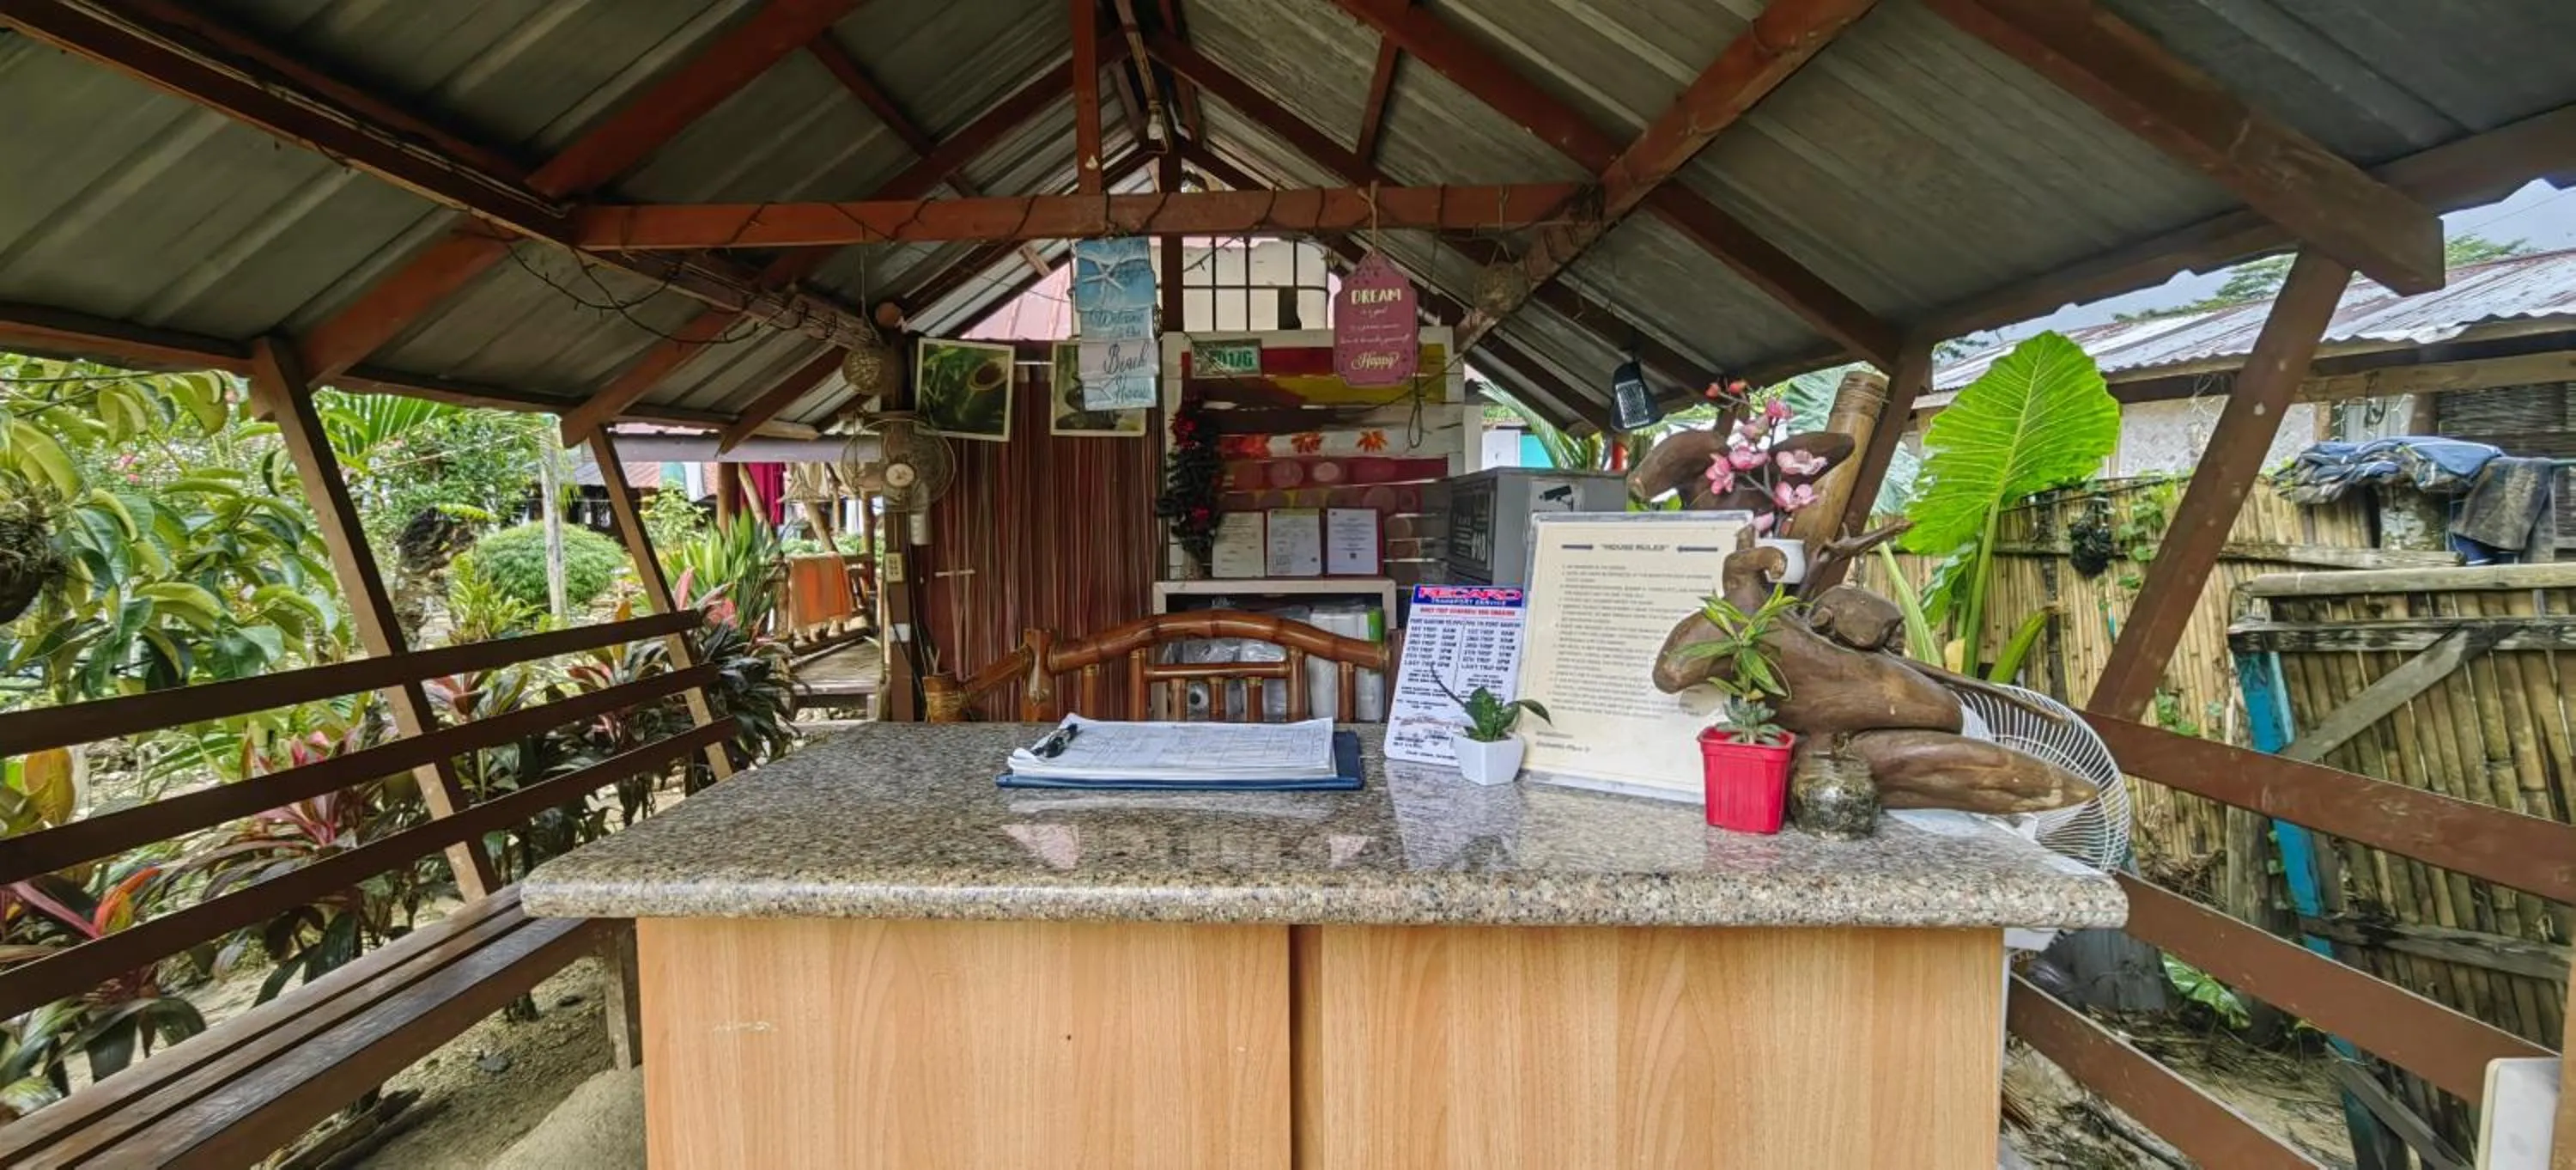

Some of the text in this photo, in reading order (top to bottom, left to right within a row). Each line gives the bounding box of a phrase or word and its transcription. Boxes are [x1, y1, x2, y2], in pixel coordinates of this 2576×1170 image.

[1351, 288, 1401, 305] DREAM
[1103, 341, 1151, 375] Beach
[1351, 350, 1400, 371] Happy
[1419, 587, 1522, 600] RECARO
